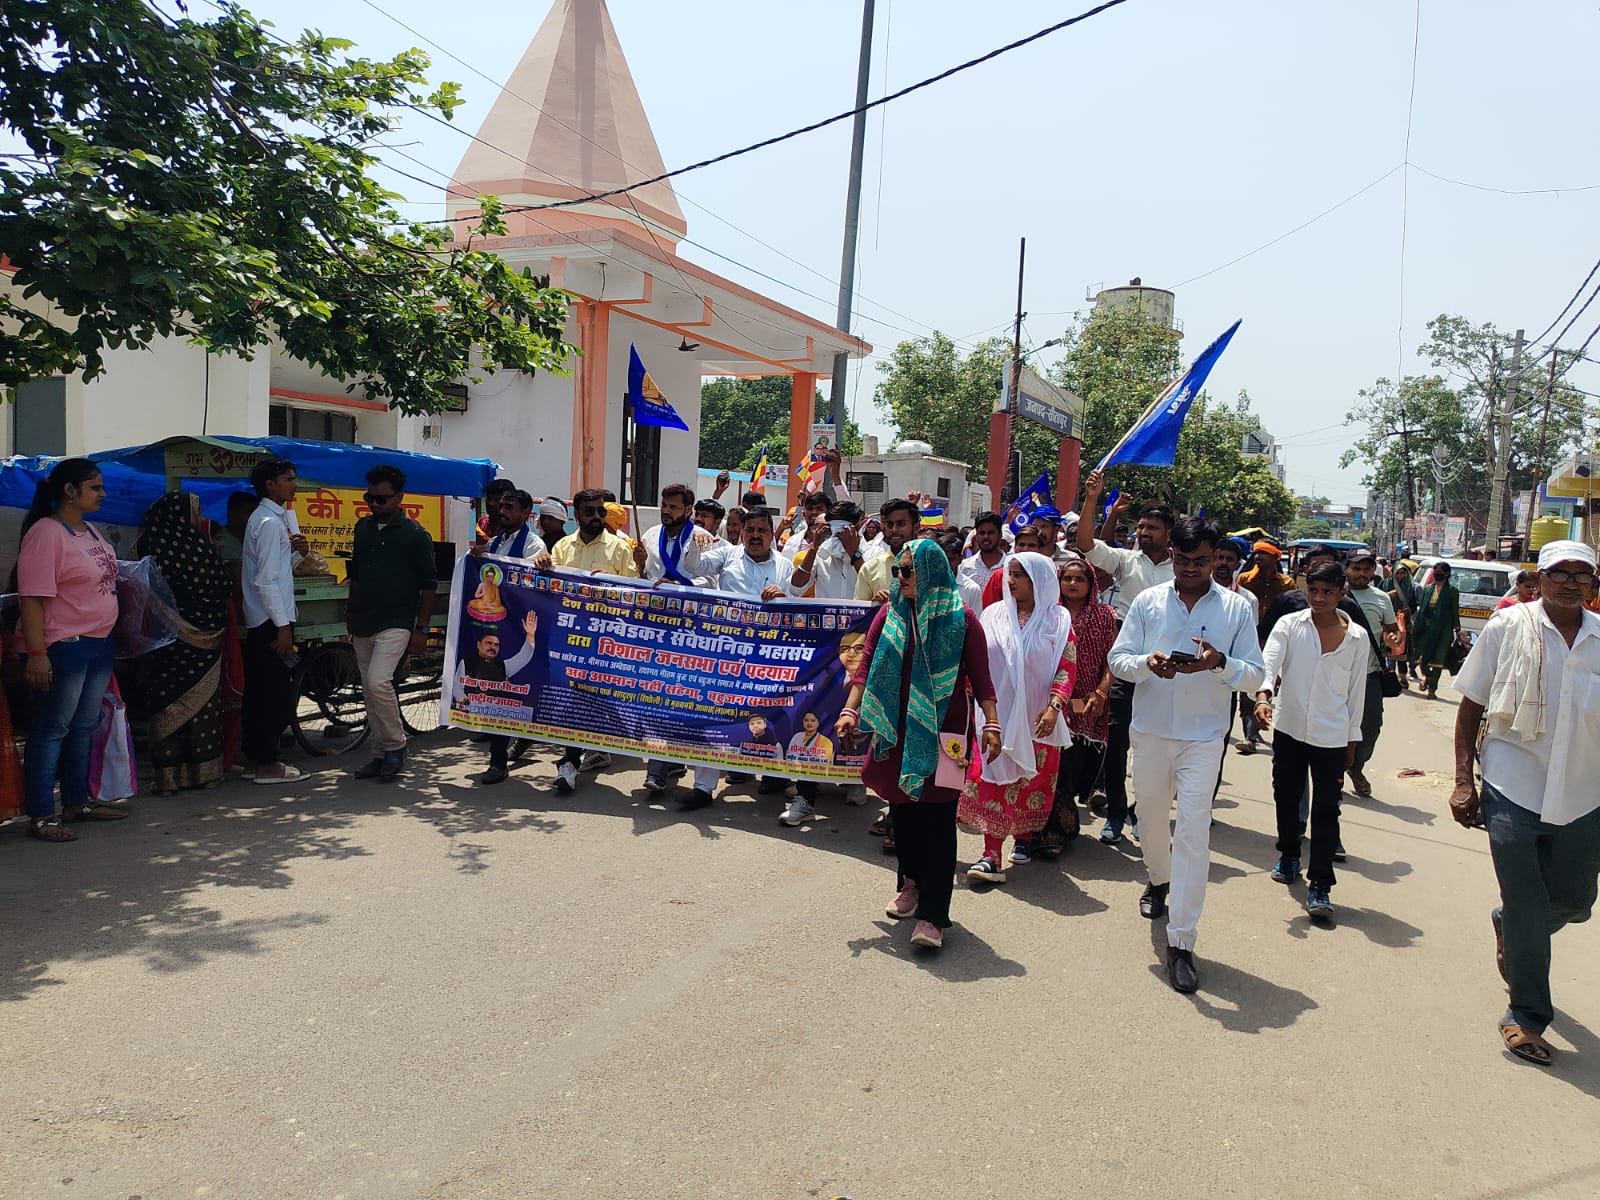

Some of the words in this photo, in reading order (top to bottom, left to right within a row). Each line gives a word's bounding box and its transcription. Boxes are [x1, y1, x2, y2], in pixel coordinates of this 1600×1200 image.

[306, 489, 343, 521] की
[562, 597, 582, 610] देश
[585, 601, 630, 618] संविधान
[634, 609, 645, 620] से
[648, 613, 682, 627] चलता
[702, 622, 741, 636] मनुवाद
[745, 627, 755, 638] से
[758, 629, 780, 640] नहीं
[567, 634, 593, 648] द्वारा
[598, 636, 655, 663] विशाल
[655, 649, 716, 674] जनसभा
[718, 659, 745, 677] एवं
[745, 662, 800, 683] पदयात्रा
[588, 616, 667, 643] अम्बेडकर
[671, 629, 756, 657] संवैधानिक
[759, 643, 816, 662] महासंघ
[479, 680, 501, 692] कुमार
[494, 697, 523, 709] अध्यक्ष
[565, 667, 588, 681] अब
[589, 671, 637, 689] अपमान
[639, 679, 665, 693] नहीं
[665, 683, 704, 701] सहेगा,
[707, 691, 746, 706] बहुजन
